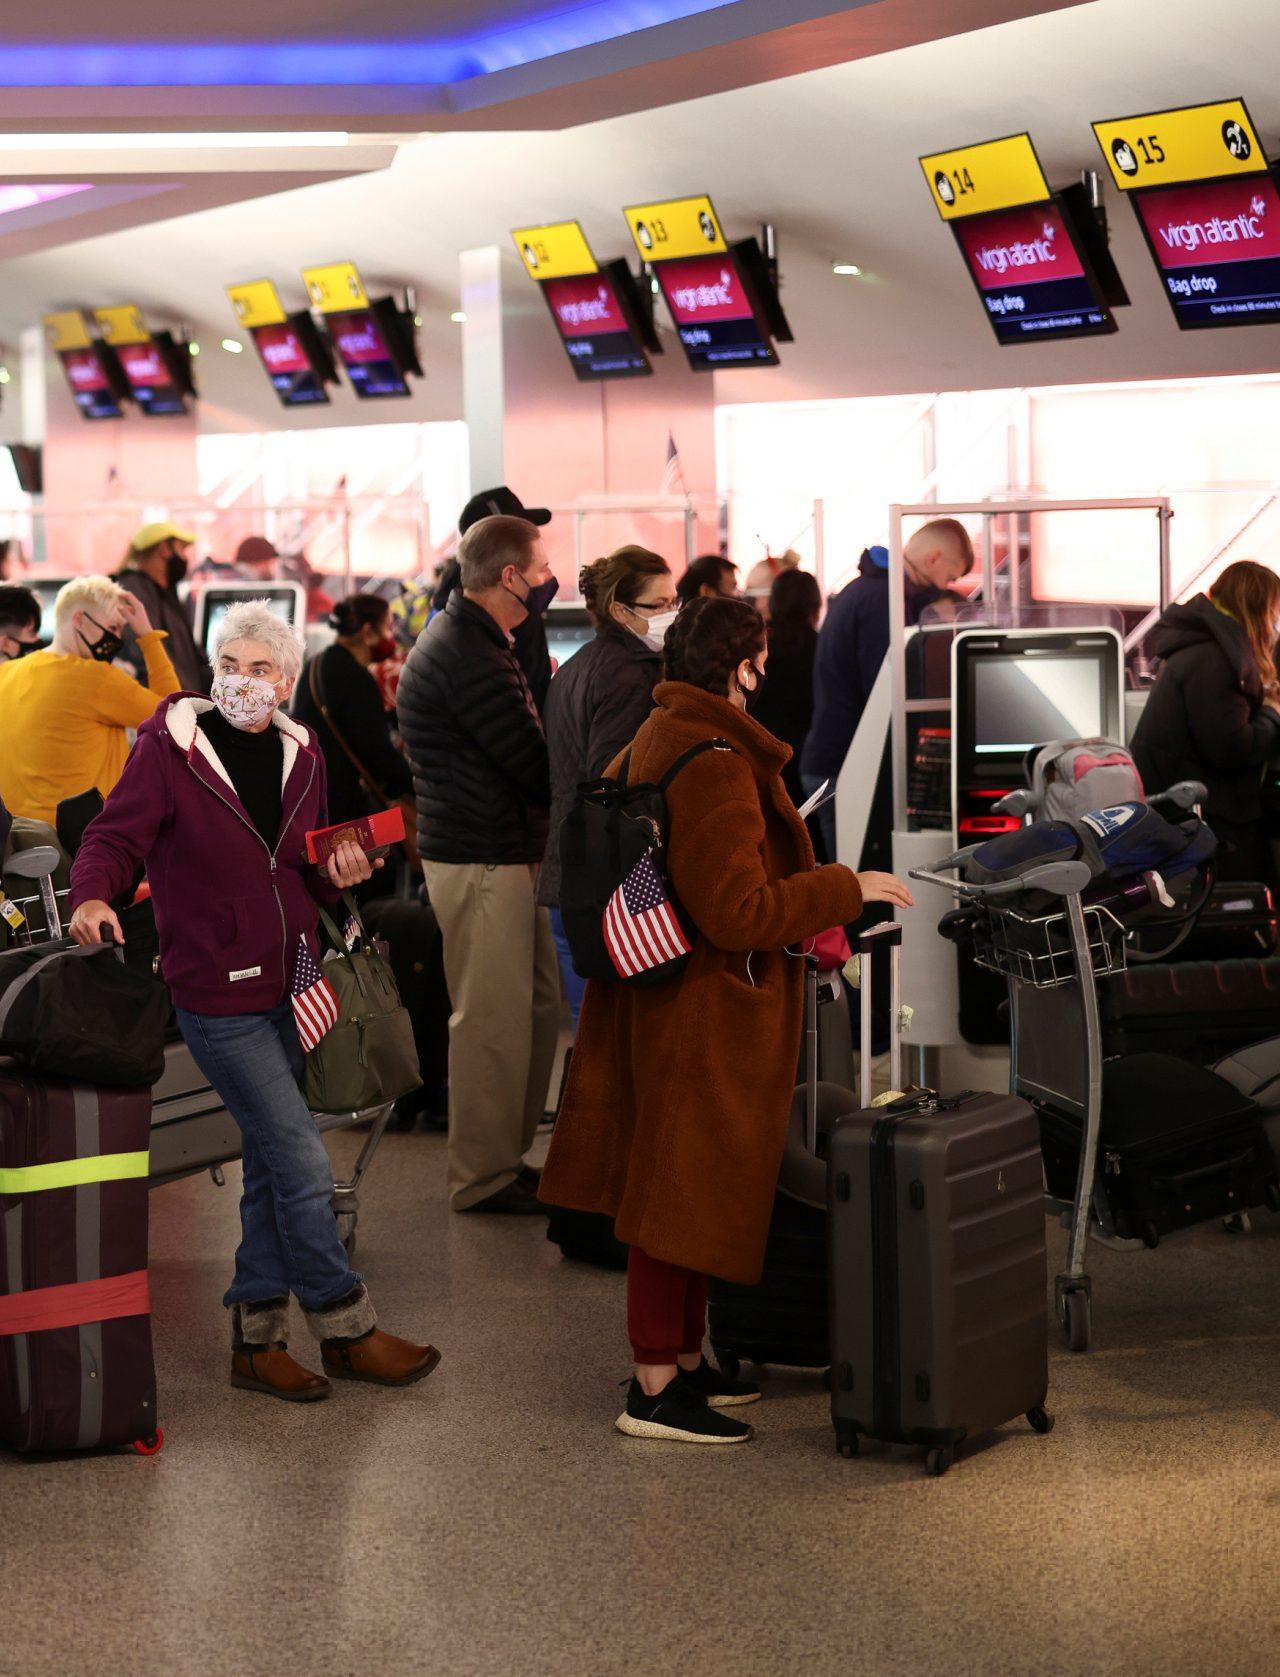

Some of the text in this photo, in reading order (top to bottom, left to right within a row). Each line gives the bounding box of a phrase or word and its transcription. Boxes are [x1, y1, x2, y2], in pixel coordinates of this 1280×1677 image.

[1136, 135, 1167, 165] 15
[952, 168, 975, 195] 14
[1167, 274, 1218, 296] Bag drop
